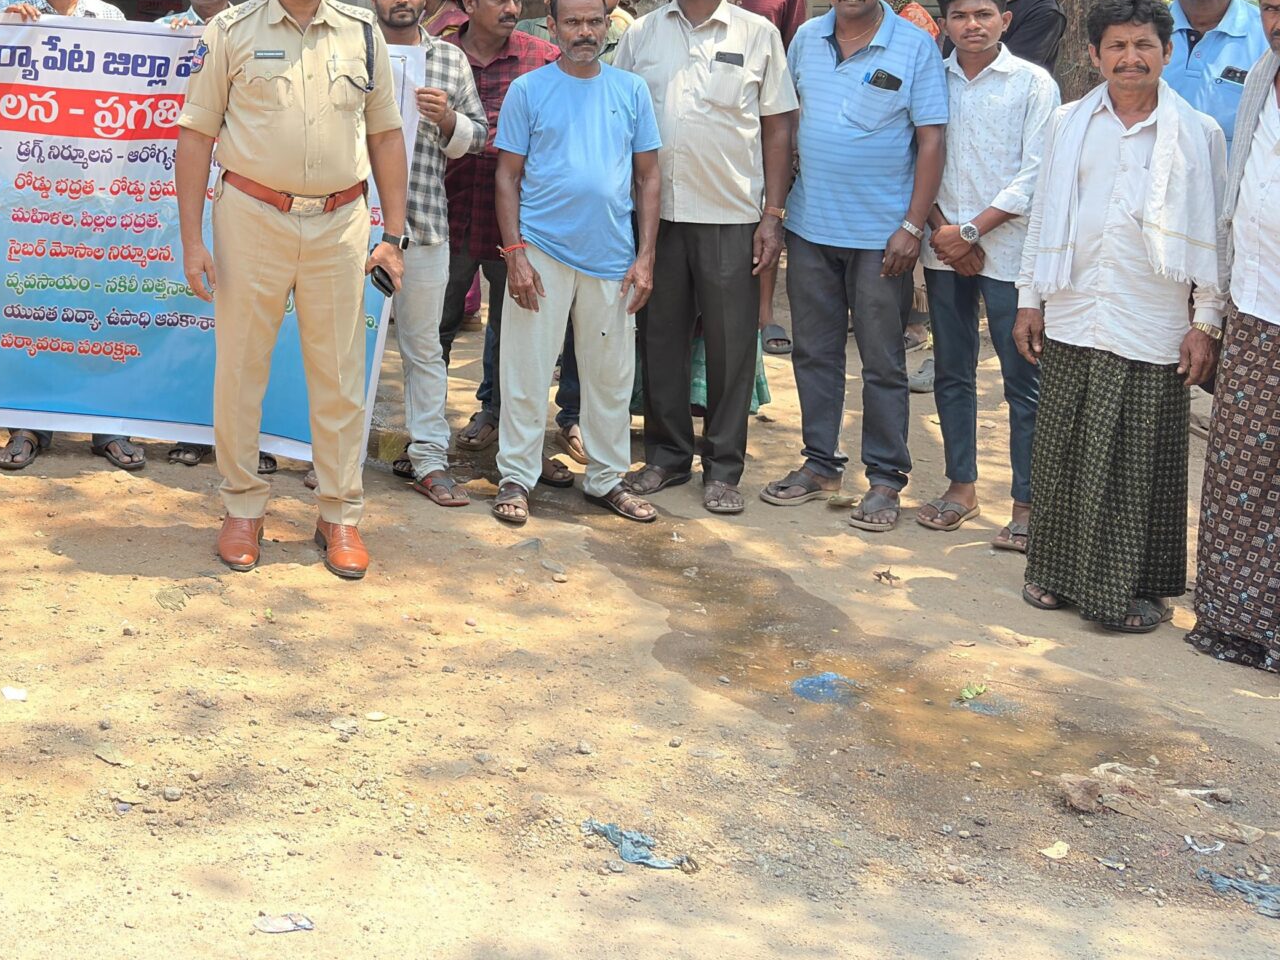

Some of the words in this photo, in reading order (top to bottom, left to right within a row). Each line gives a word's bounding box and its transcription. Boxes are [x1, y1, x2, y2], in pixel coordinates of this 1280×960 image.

[103, 51, 170, 86] జిల్లా
[14, 171, 52, 198] రోడ్డు
[55, 179, 95, 200] భద్రత
[109, 178, 146, 202] రోడ్డు
[80, 211, 117, 232] పిల్లల
[8, 239, 46, 262] సైబర్
[49, 242, 105, 260] మోసాల
[6, 272, 90, 295] వ్యవసాయం
[105, 277, 138, 293] నకిలీ
[3, 304, 58, 322] యువత
[106, 308, 152, 328] ఉపాధి
[0, 333, 74, 356] పర్యావరణ
